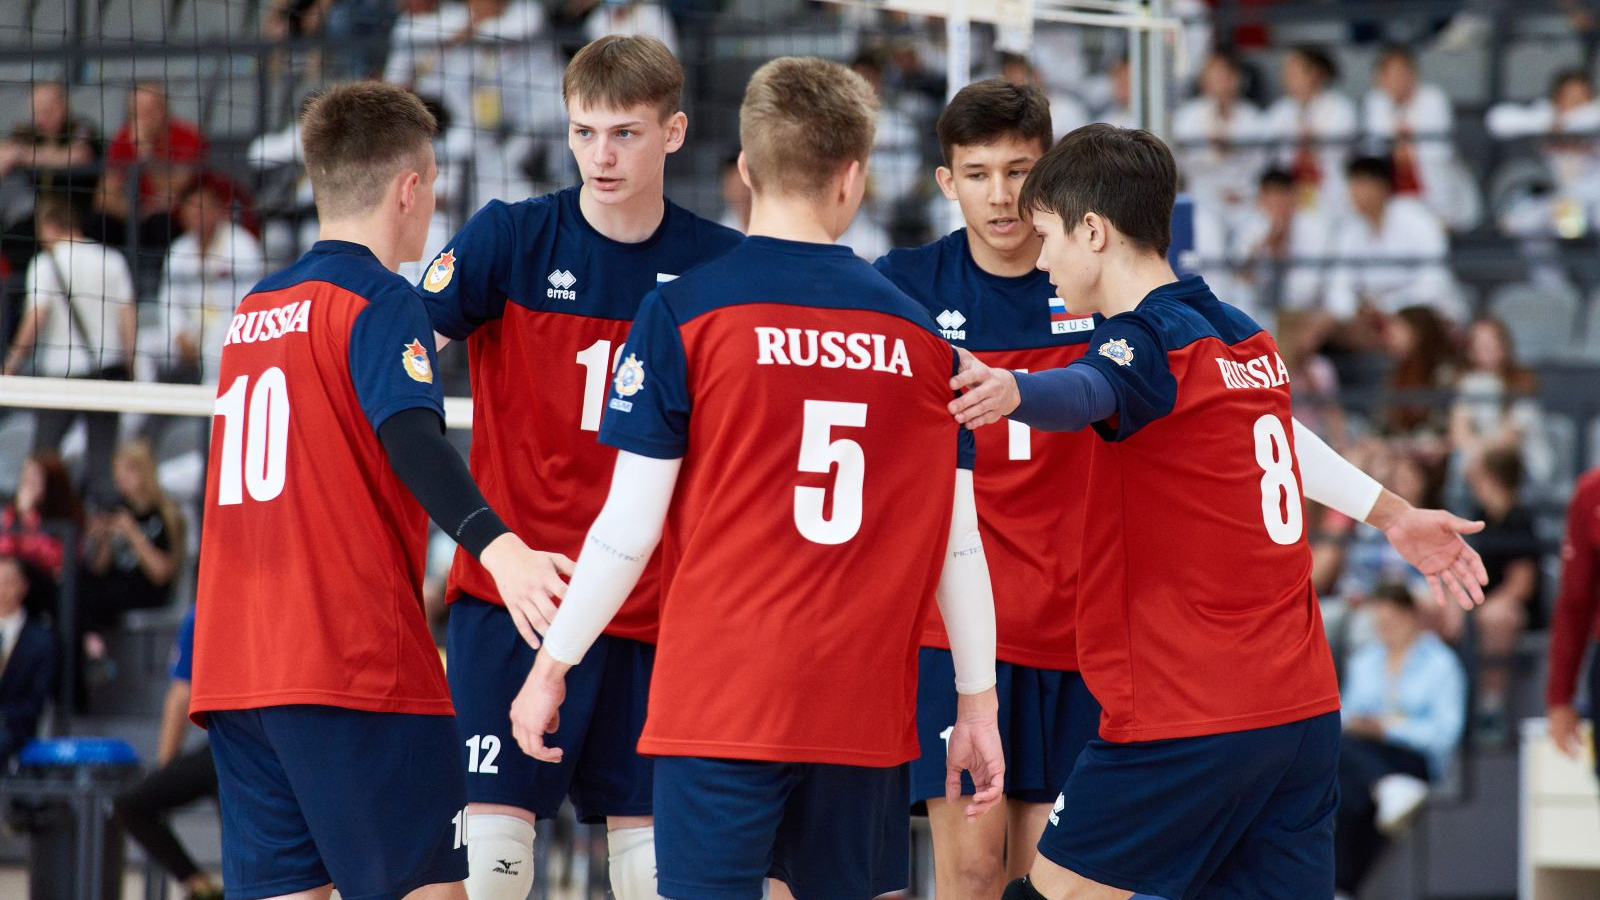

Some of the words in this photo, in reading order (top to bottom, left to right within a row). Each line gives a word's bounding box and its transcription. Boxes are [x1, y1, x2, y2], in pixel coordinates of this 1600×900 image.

[223, 299, 311, 348] RUSSIA
[939, 328, 966, 341] rrea
[755, 326, 913, 378] RUSSIA
[1215, 352, 1291, 390] RUSSIA
[576, 339, 628, 432] 1
[213, 366, 290, 506] 10
[793, 400, 868, 545] 5
[1253, 413, 1303, 545] 8
[466, 734, 501, 774] 12
